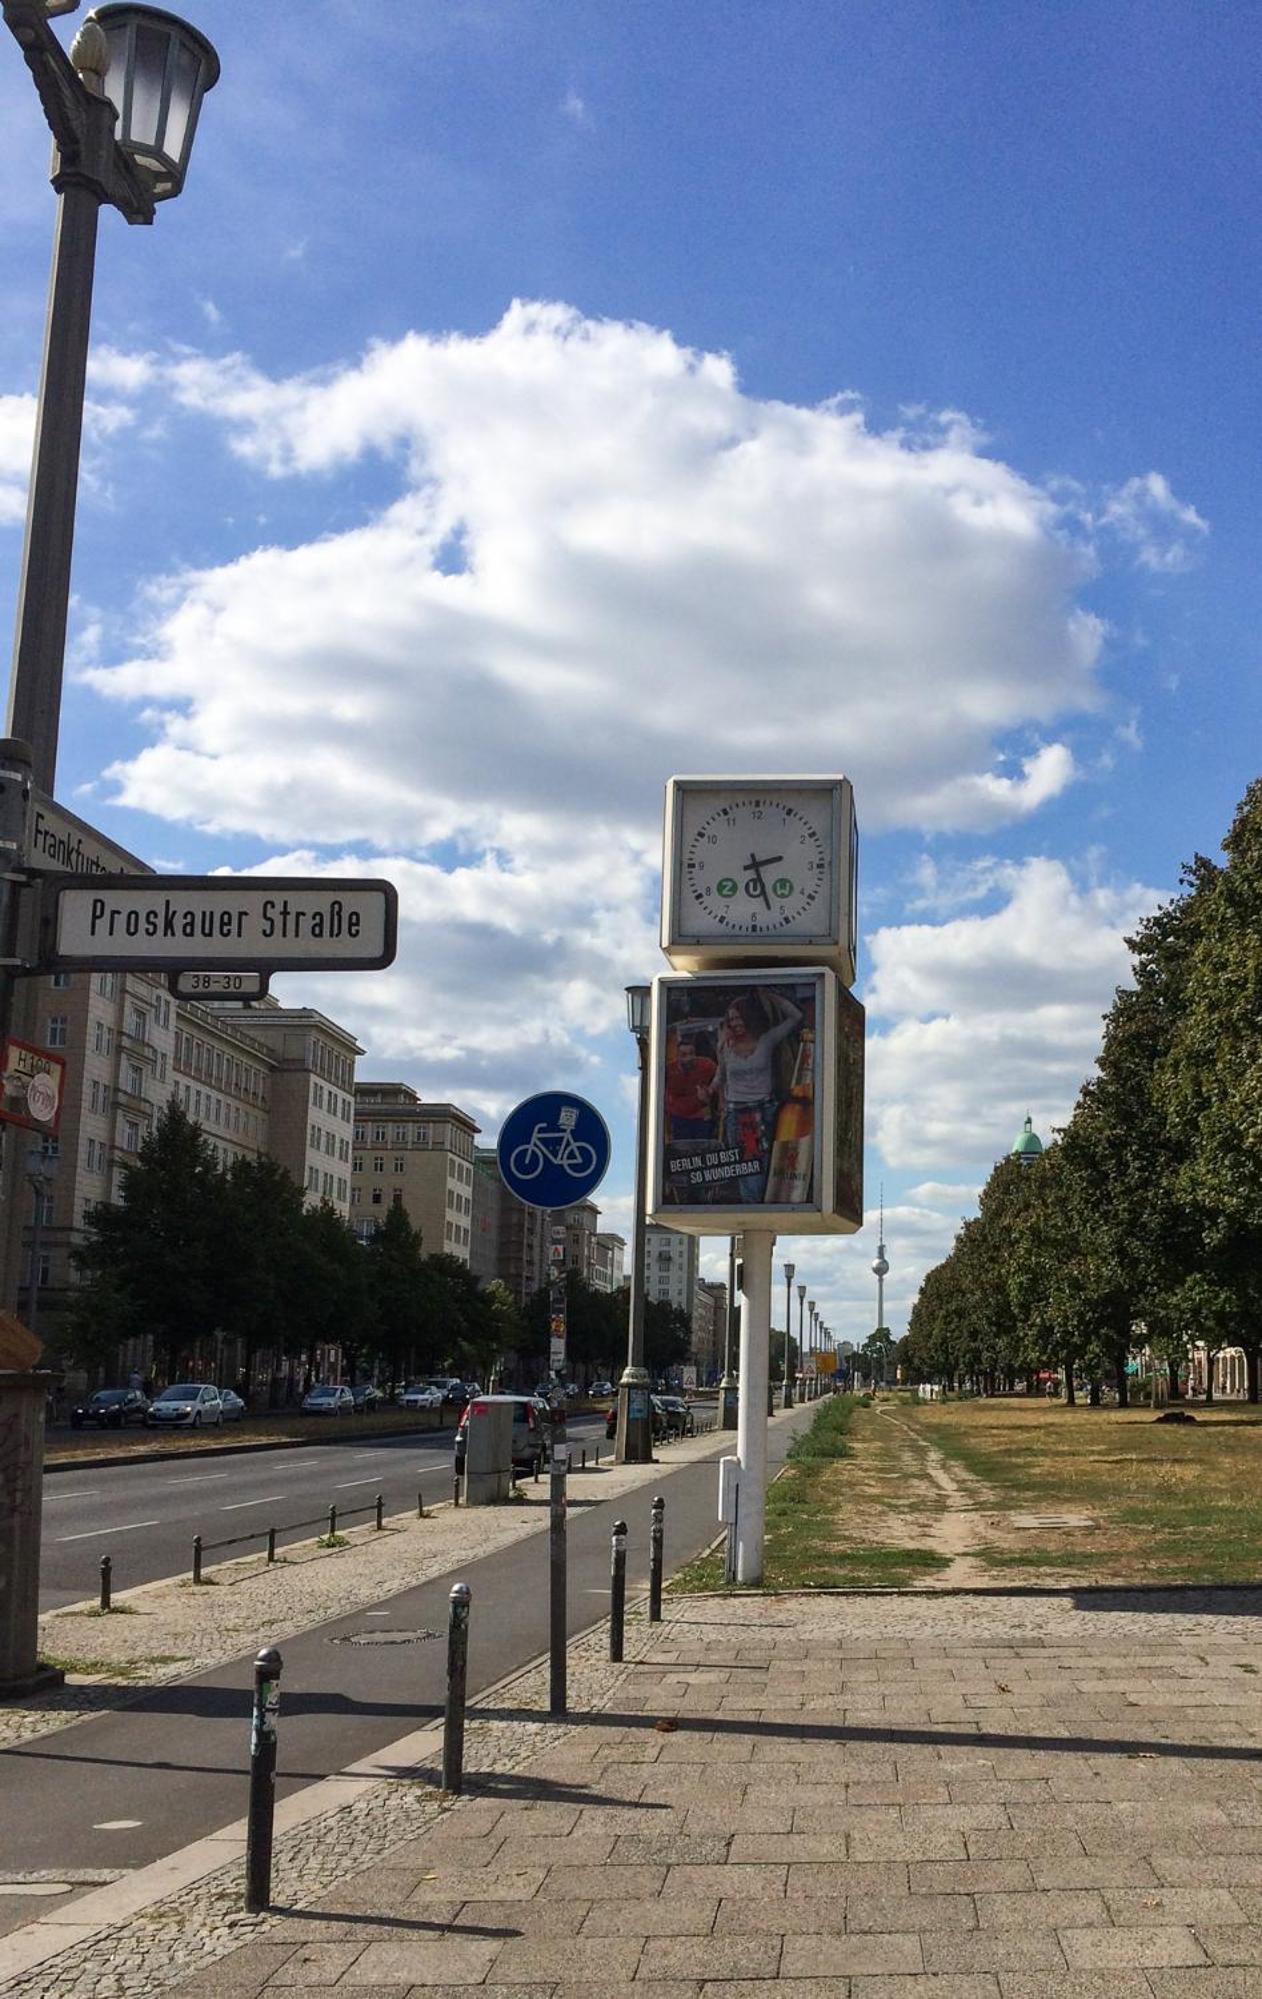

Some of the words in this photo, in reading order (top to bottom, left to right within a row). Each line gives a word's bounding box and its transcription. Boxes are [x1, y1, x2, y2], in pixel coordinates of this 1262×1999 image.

[752, 810, 763, 820] 12
[726, 818, 736, 827] 11
[34, 812, 112, 874] Frankfurt
[707, 834, 718, 845] 10
[800, 835, 806, 845] 2
[698, 861, 704, 871] 9
[807, 861, 813, 871] 3
[705, 886, 711, 897] 8
[799, 887, 805, 896] 4
[724, 904, 730, 914] 7
[780, 905, 786, 915] 5
[90, 898, 249, 938] Proskauer
[261, 899, 361, 939] Straße
[751, 912, 757, 923] 6
[191, 975, 243, 990] 38-30
[706, 1153, 718, 1166] DU
[690, 1171, 702, 1184] SO
[704, 1160, 760, 1182] WUNDERBAR
